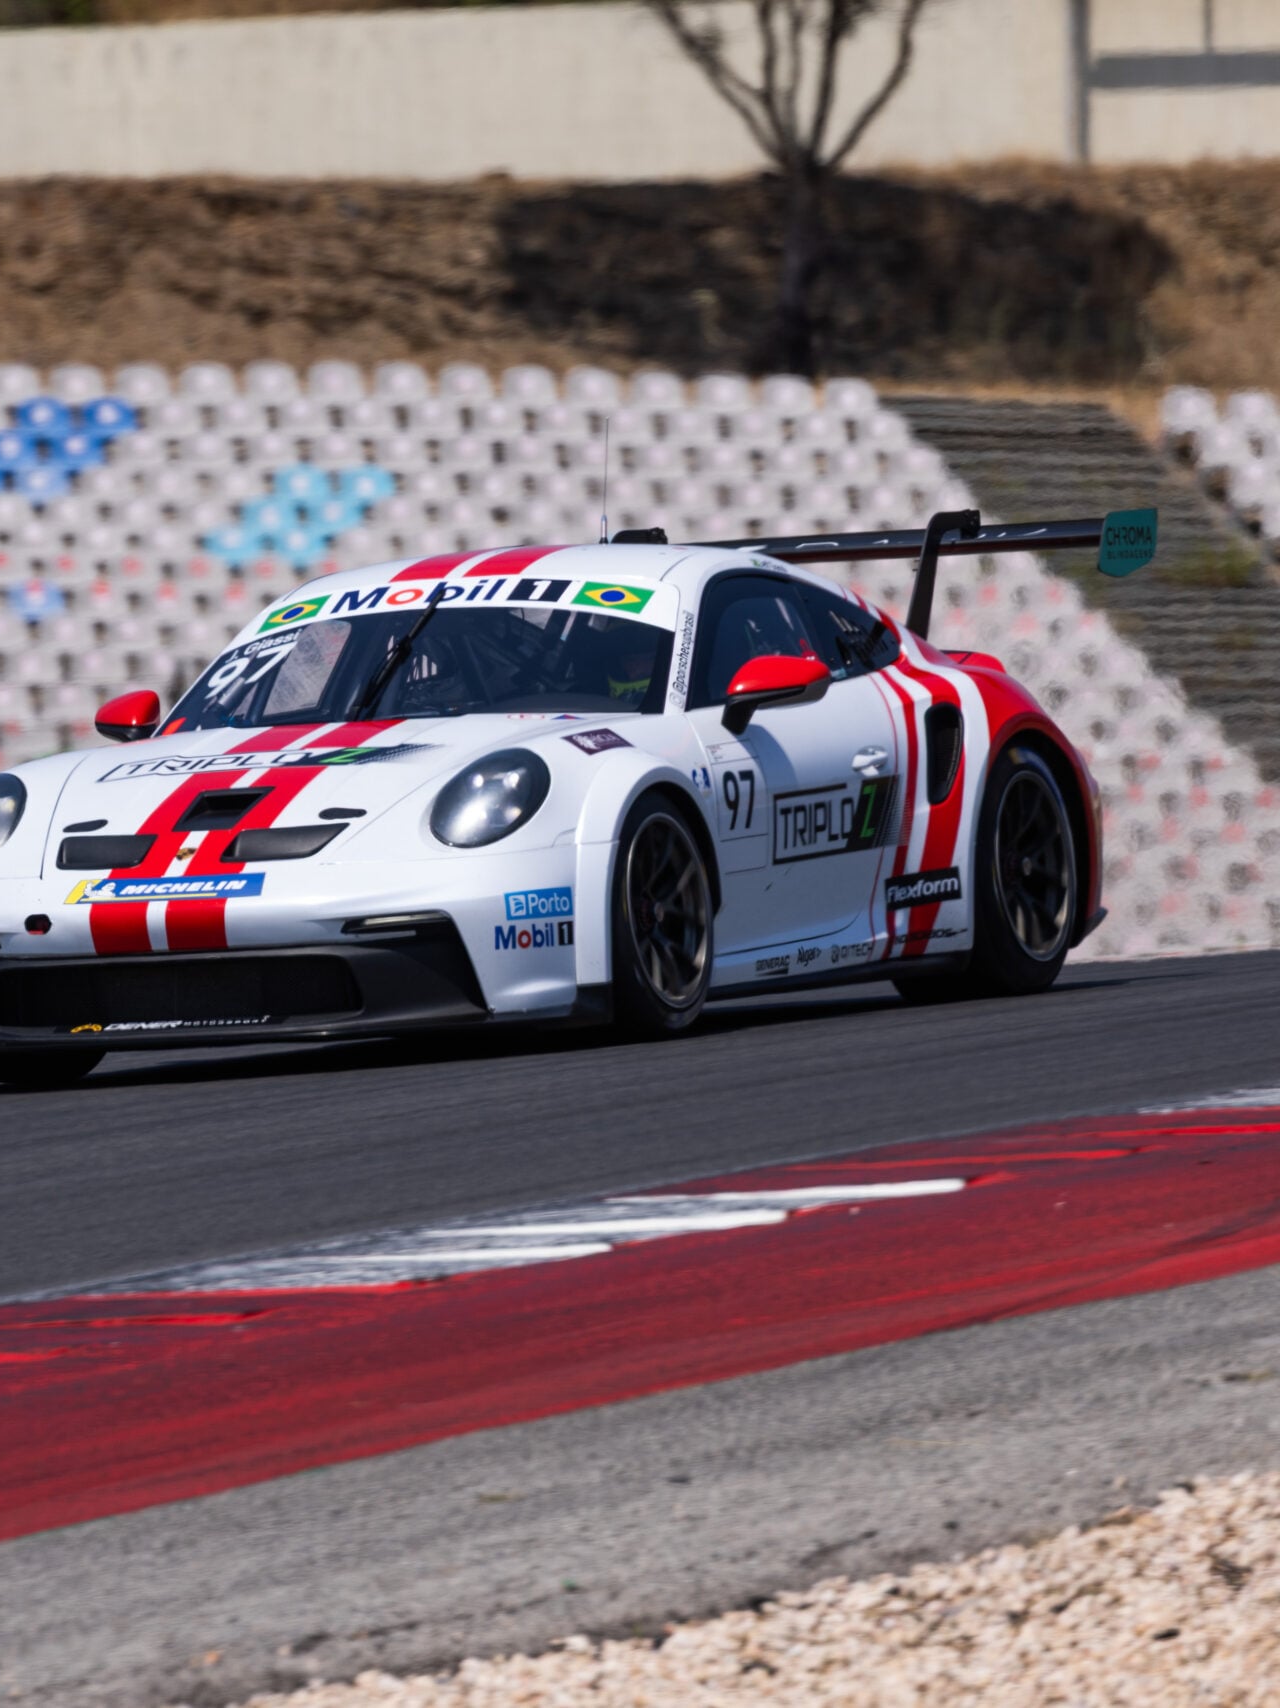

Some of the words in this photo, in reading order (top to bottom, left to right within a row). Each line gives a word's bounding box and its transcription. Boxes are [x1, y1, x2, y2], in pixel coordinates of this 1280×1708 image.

[1106, 526, 1152, 546] CHROMA
[330, 578, 508, 614] Mobil
[204, 640, 298, 699] 97
[722, 770, 755, 831] 97
[779, 797, 855, 850] TRIPLO
[860, 784, 877, 838] Z
[119, 880, 248, 896] MICHELIN
[527, 892, 570, 915] Porto
[494, 922, 555, 950] Mobil
[559, 922, 571, 946] 1
[103, 1020, 183, 1031] DENER
